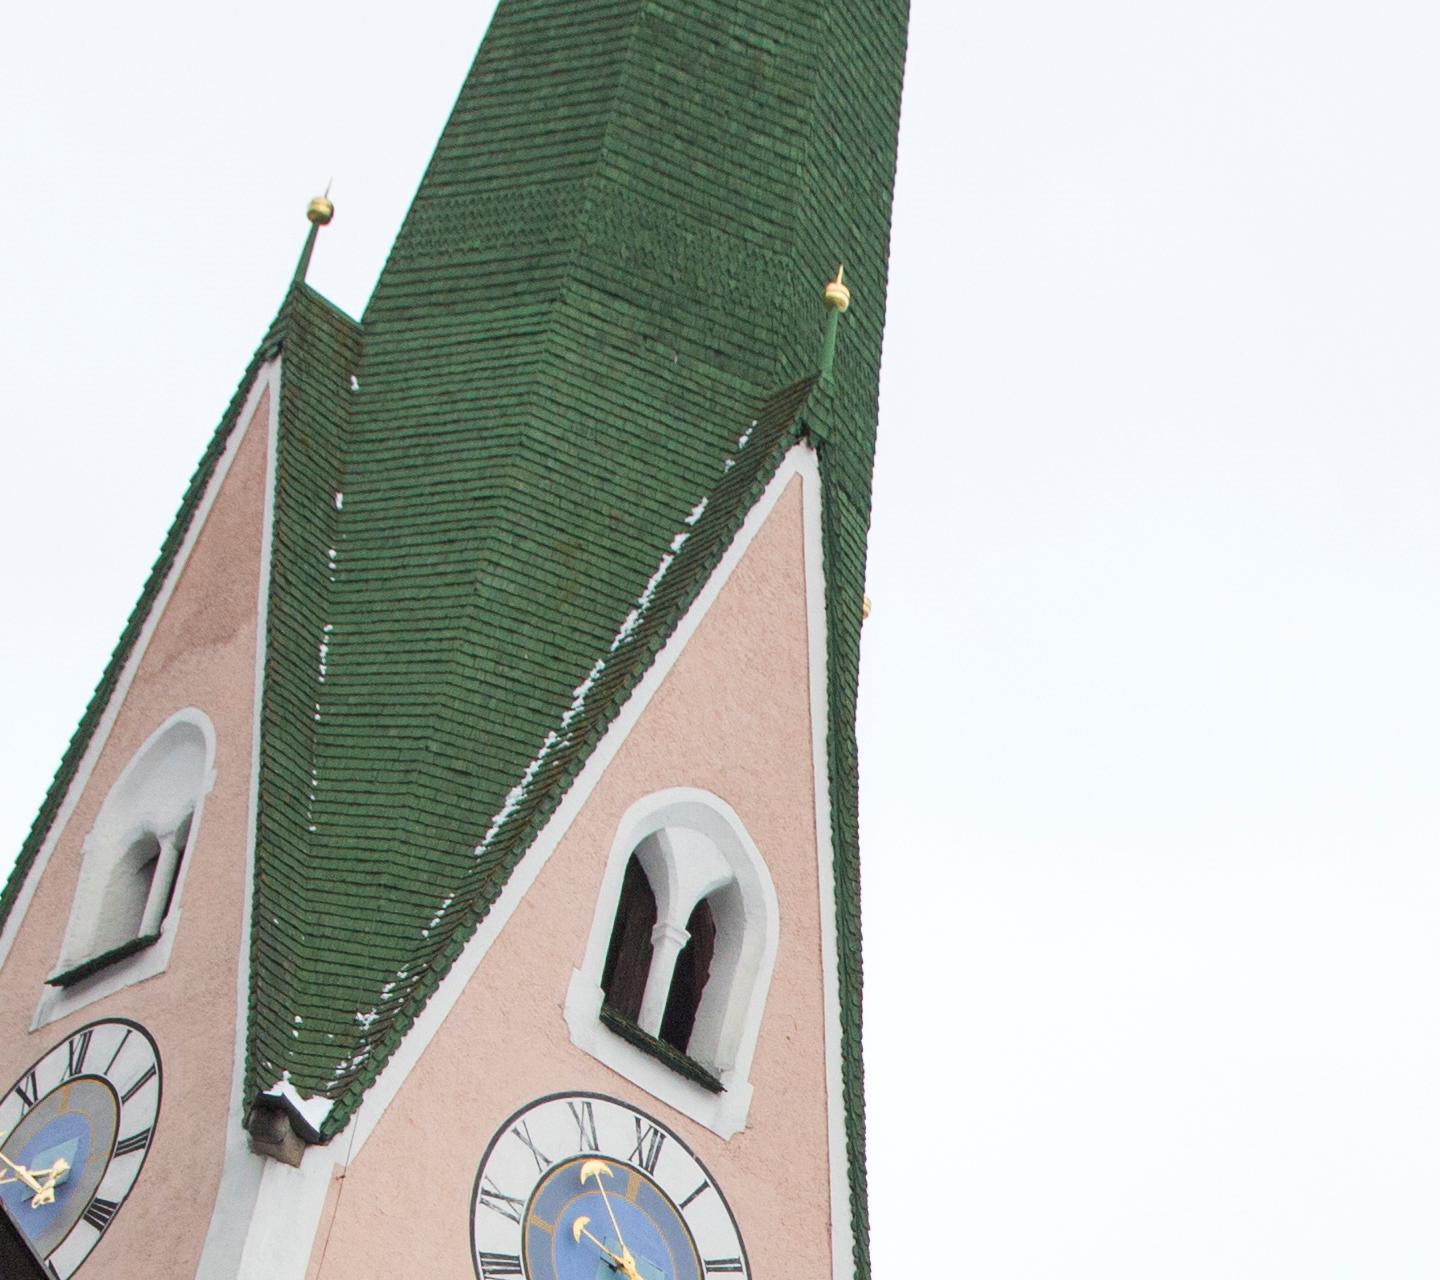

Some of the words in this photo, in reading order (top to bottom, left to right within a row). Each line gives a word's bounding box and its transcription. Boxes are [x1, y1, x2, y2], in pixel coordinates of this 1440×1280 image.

[60, 1029, 93, 1081] XII
[104, 1029, 133, 1076] I
[122, 1063, 157, 1103] II
[114, 1128, 151, 1158] III
[511, 1120, 553, 1173] X
[568, 1101, 600, 1152] XI
[629, 1116, 667, 1176] XII
[480, 1176, 525, 1223] IX
[680, 1179, 710, 1209] I
[705, 1257, 743, 1273] II
